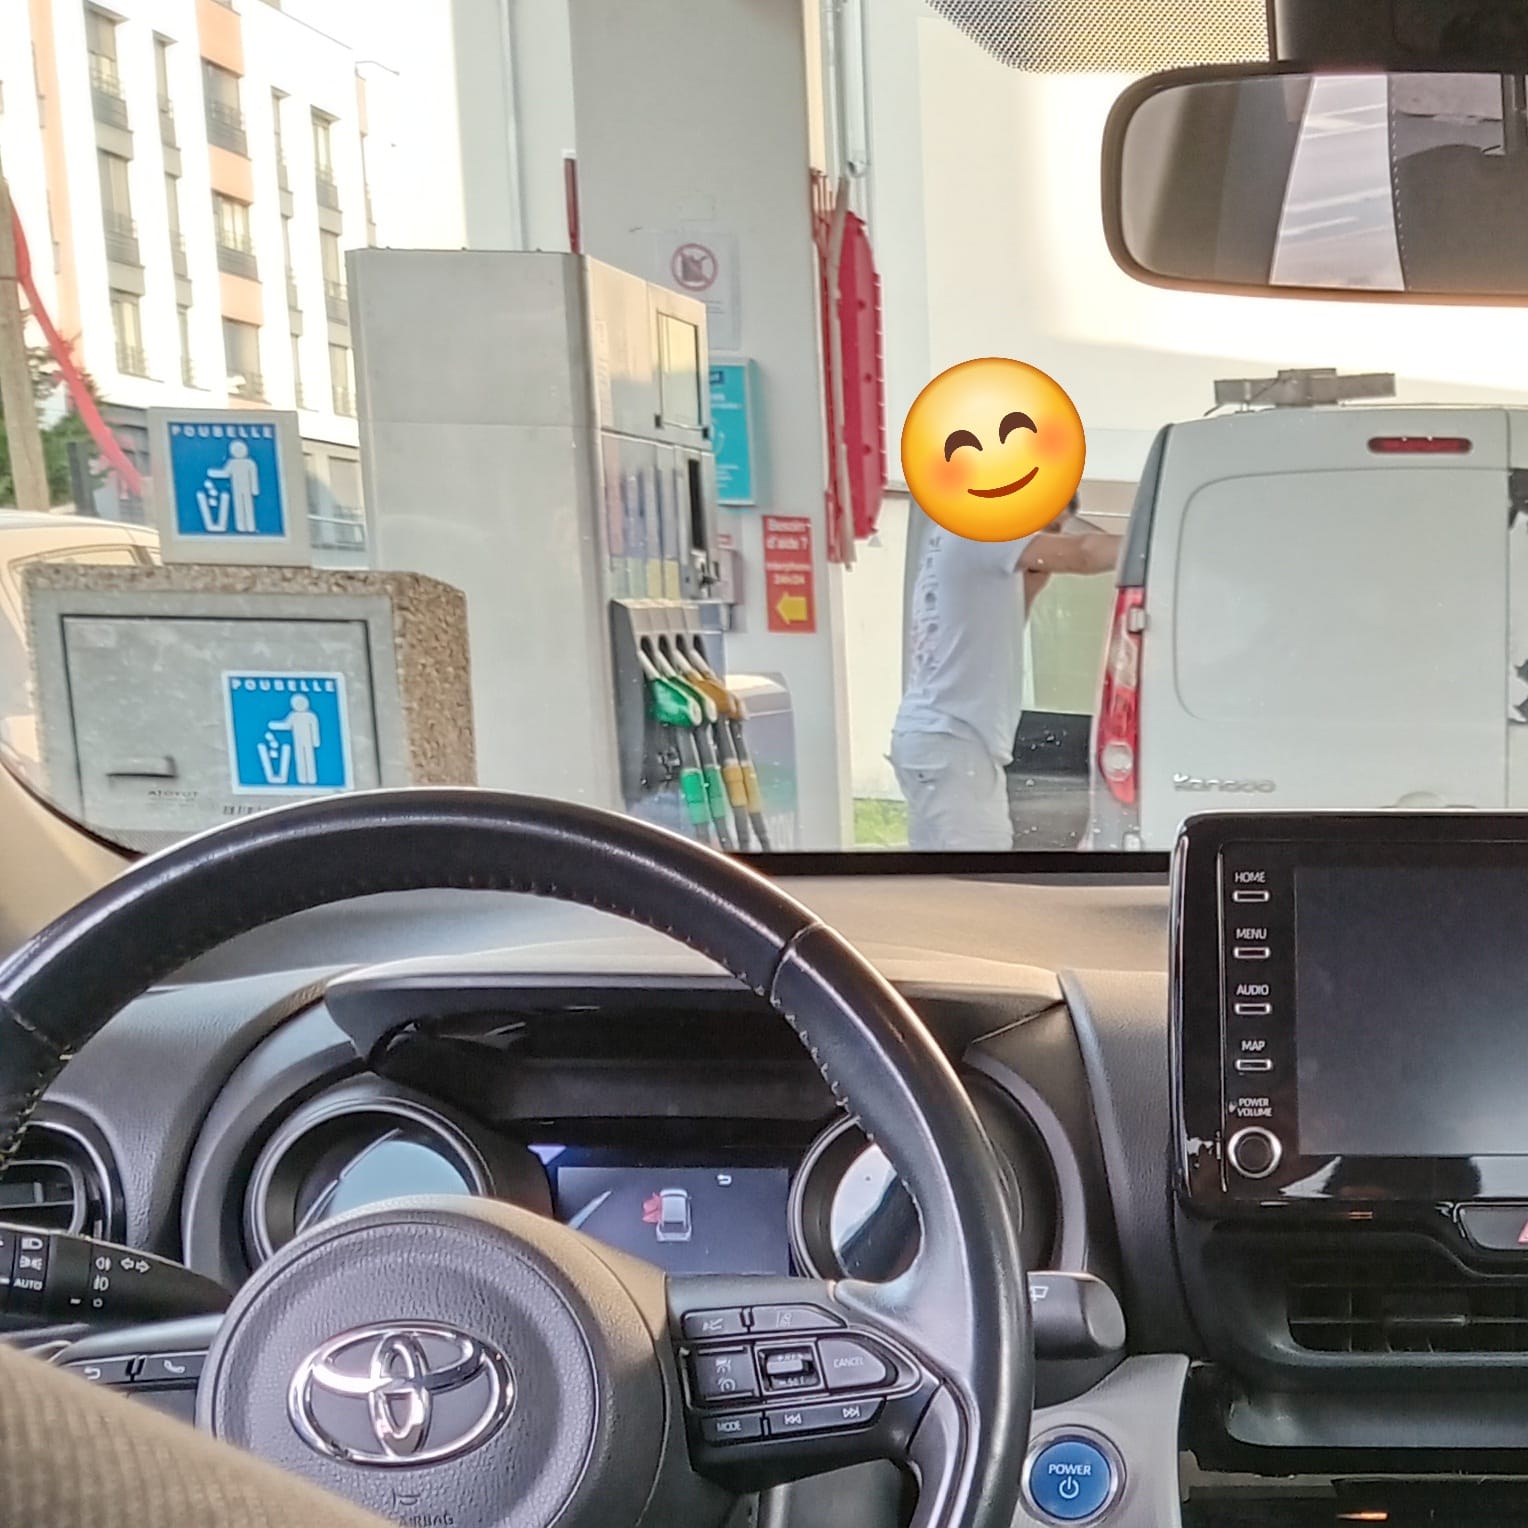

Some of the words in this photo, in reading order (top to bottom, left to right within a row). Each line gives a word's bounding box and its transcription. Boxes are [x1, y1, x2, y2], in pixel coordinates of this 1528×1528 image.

[170, 424, 273, 438] POUBELLE
[231, 679, 335, 692] POUBELLE
[1234, 871, 1266, 883] HOME
[1236, 928, 1267, 939] MENU
[1236, 984, 1269, 996] AUDIO
[1241, 1040, 1266, 1051] MAP
[1239, 1098, 1269, 1107] POWER
[1237, 1107, 1272, 1117] VOLUME
[13, 1278, 43, 1291] AUTO
[833, 1356, 864, 1369] CANCEL
[717, 1420, 742, 1431] MODE
[1048, 1463, 1091, 1475] POWER
